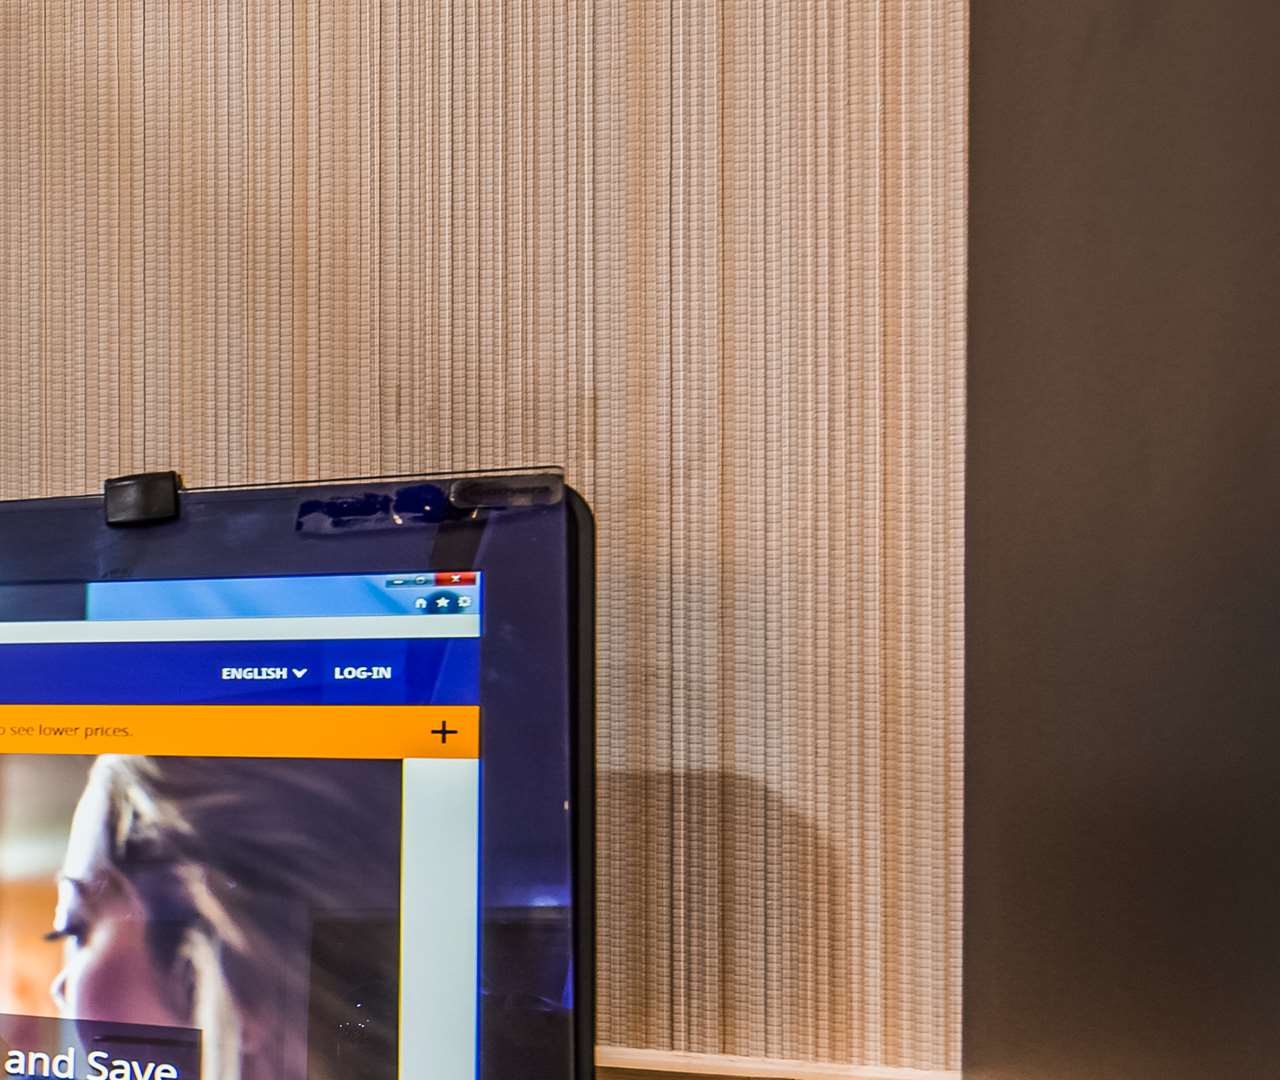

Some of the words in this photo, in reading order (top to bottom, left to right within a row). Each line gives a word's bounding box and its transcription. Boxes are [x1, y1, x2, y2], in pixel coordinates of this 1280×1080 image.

[222, 667, 288, 679] ENGLISH
[334, 666, 392, 679] LOG-IN
[10, 727, 34, 736] see
[39, 724, 79, 737] lower
[84, 725, 134, 739] prices.
[4, 1047, 75, 1080] and
